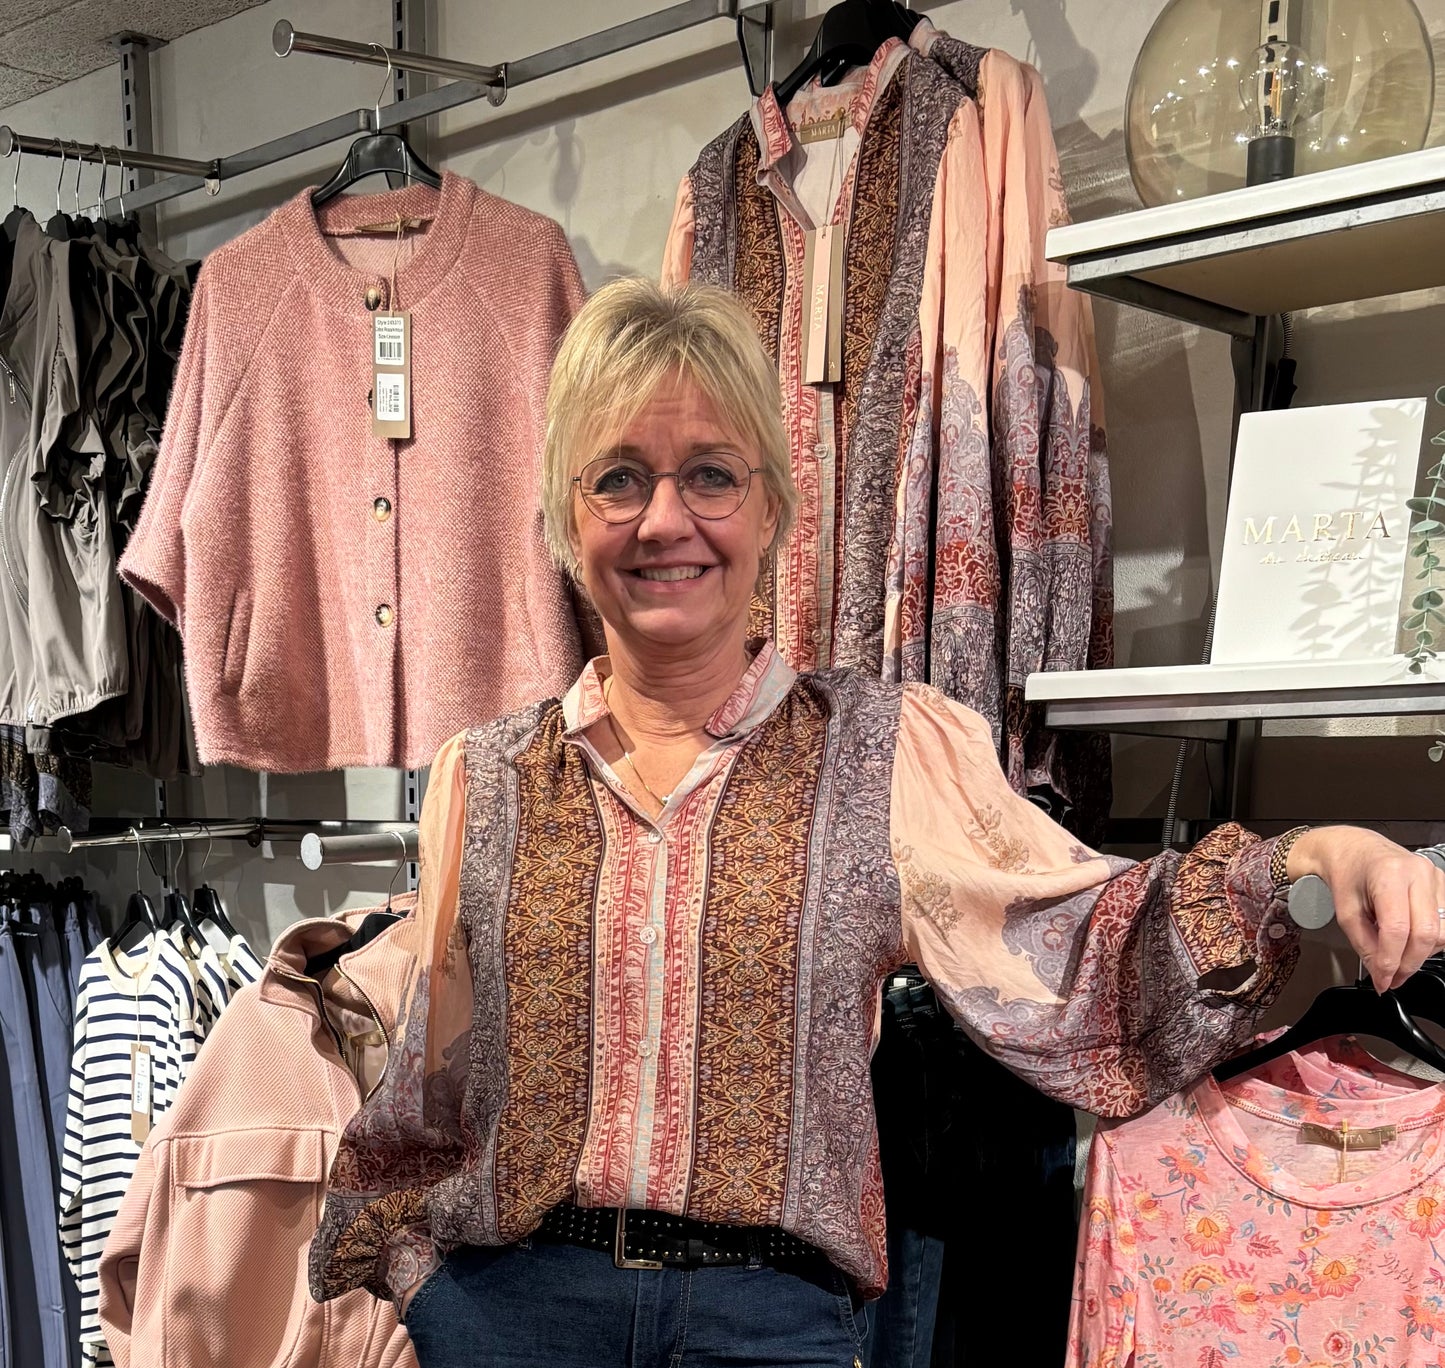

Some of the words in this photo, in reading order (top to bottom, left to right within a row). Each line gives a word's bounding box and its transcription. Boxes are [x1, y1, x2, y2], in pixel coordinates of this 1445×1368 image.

[811, 124, 836, 136] MARTA
[814, 284, 825, 331] MARTA
[1241, 510, 1392, 546] MARTA
